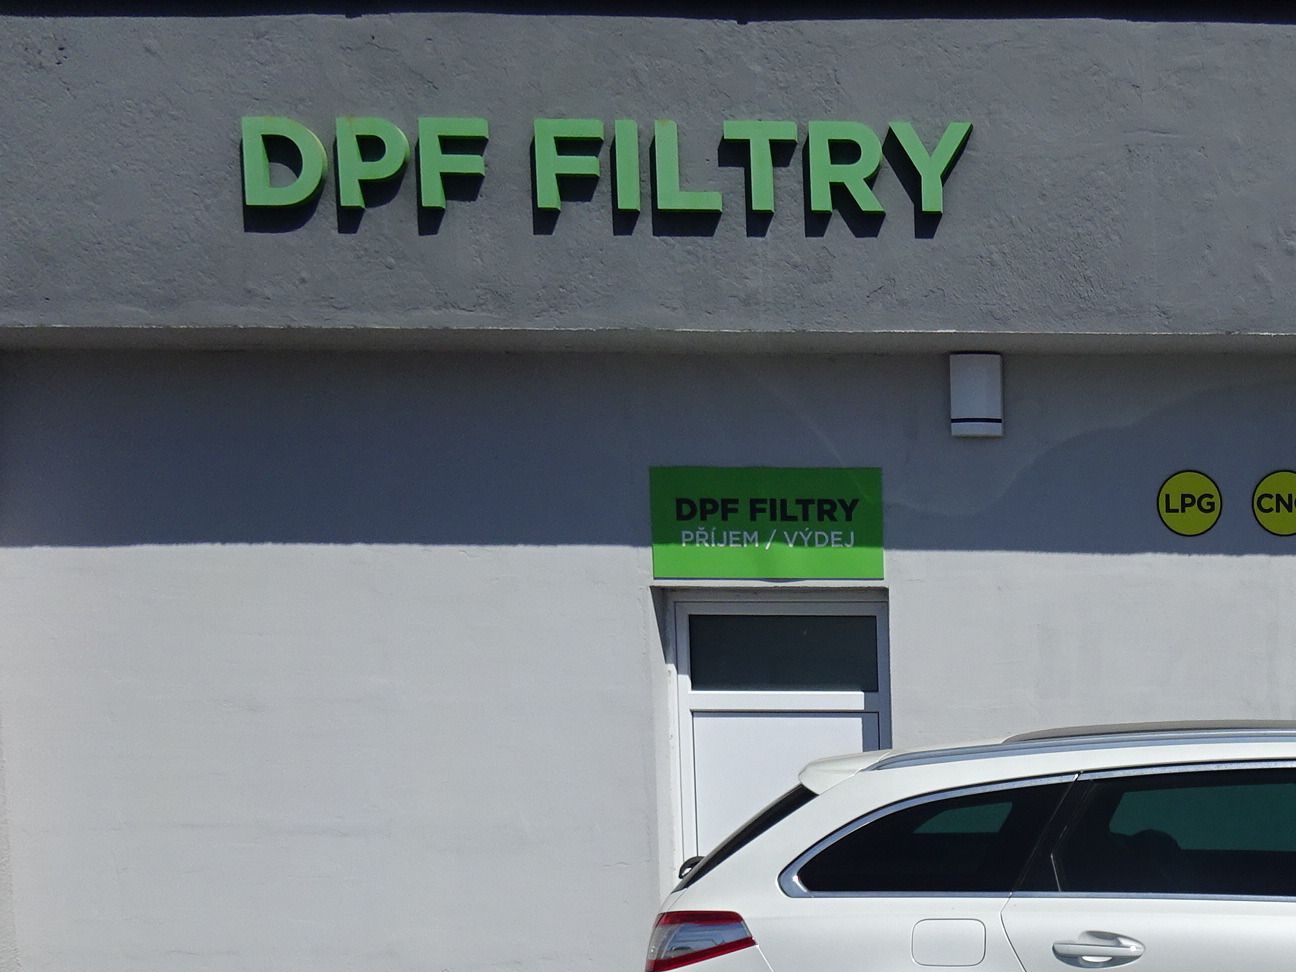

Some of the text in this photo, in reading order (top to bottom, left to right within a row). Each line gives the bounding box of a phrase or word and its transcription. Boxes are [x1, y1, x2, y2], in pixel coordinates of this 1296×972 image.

[240, 116, 975, 214] DPF FILTRY
[675, 498, 860, 522] DPF FILTRY
[1165, 493, 1215, 514] LPG
[681, 527, 856, 550] PŘÍJEM / VÝDEJ
